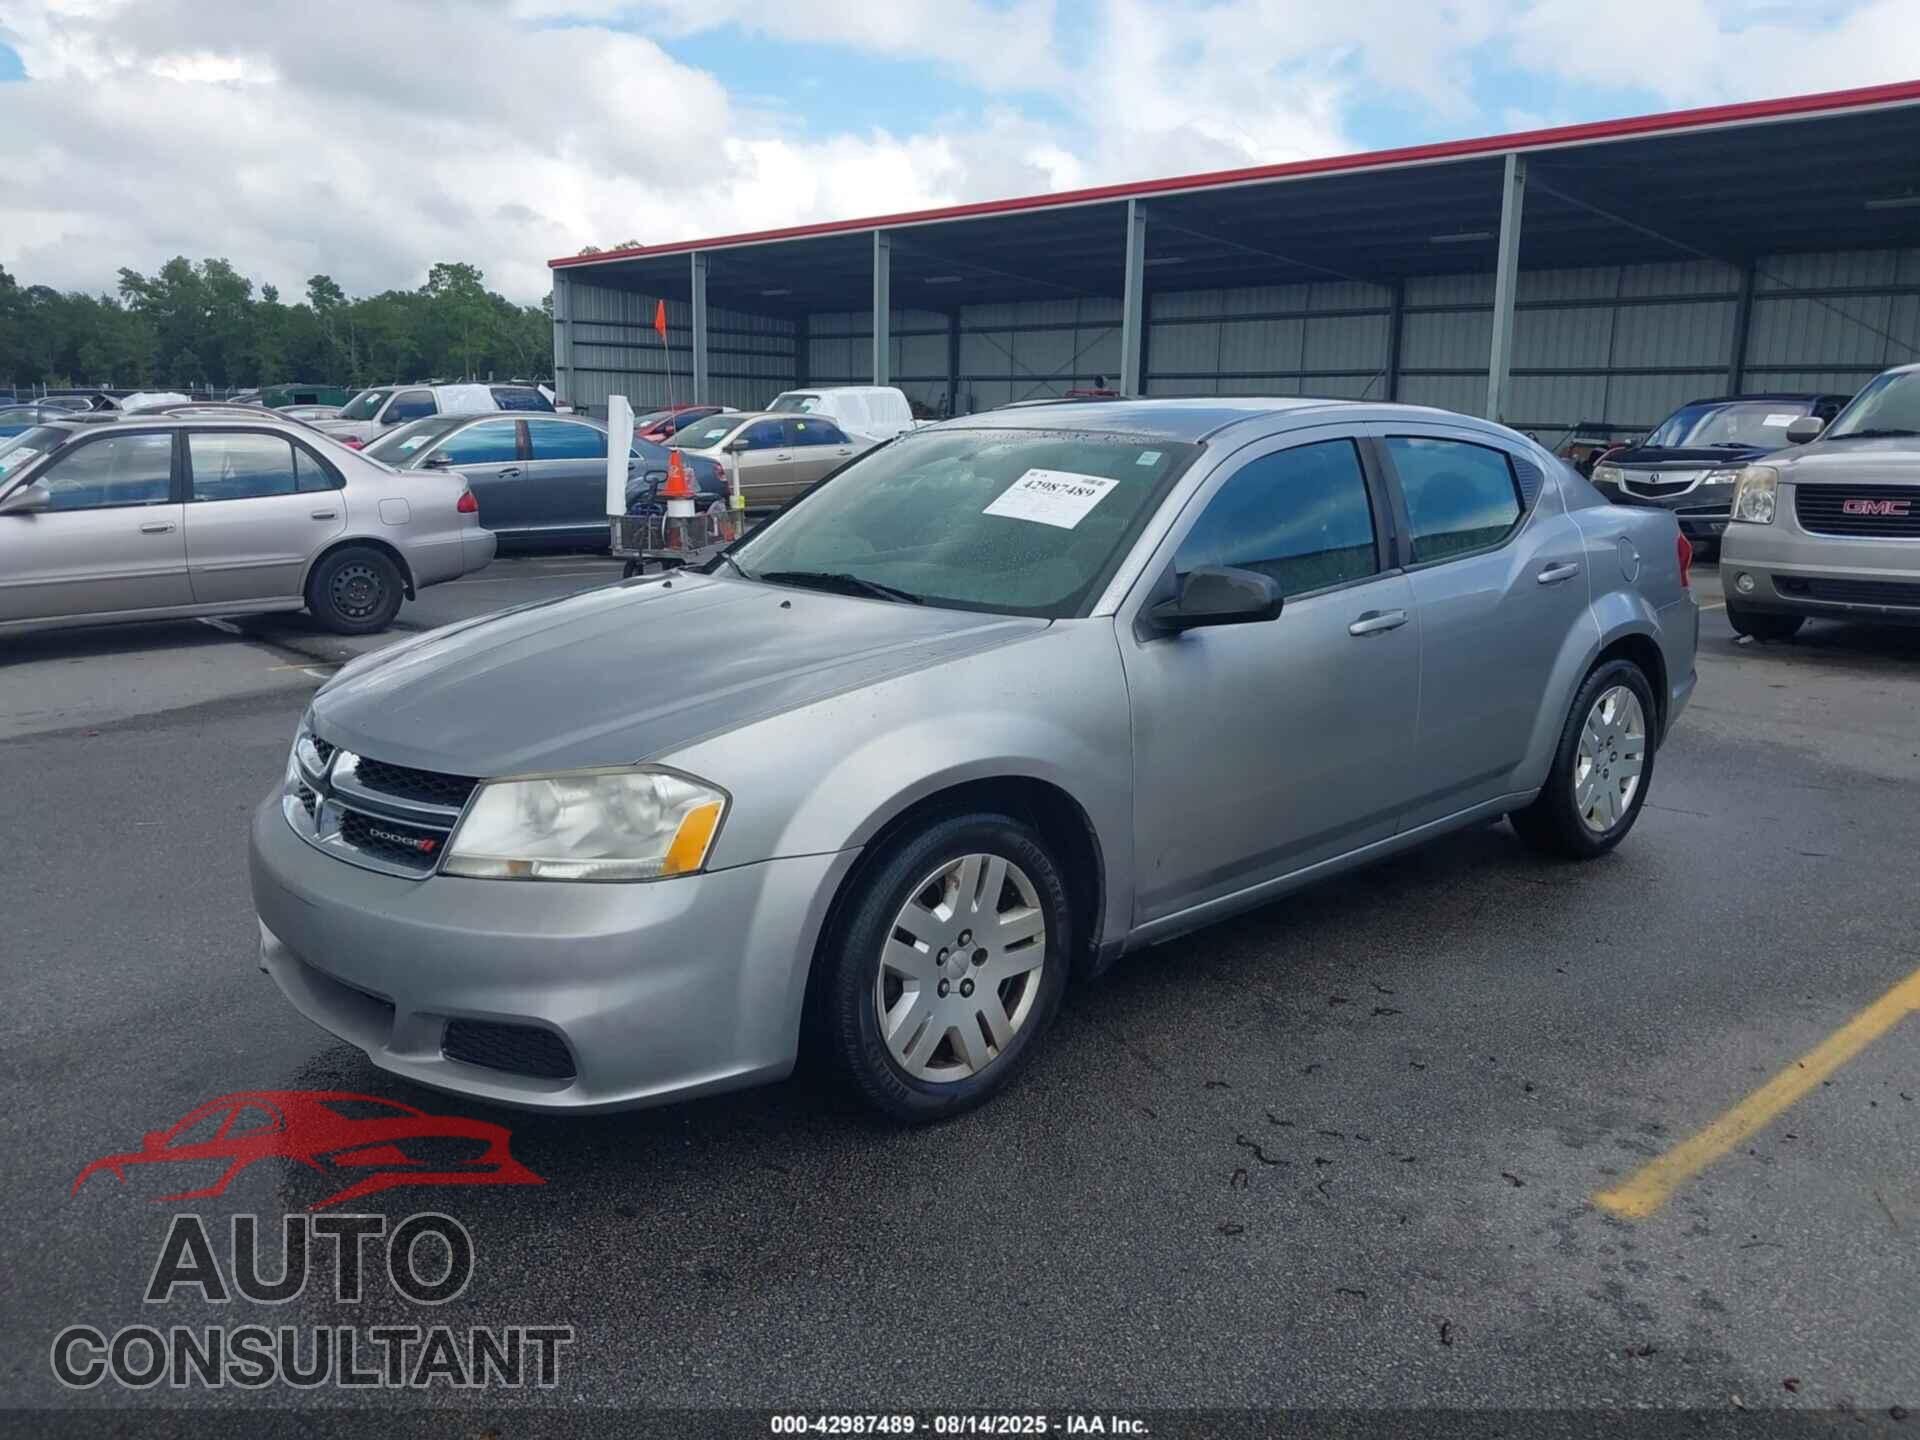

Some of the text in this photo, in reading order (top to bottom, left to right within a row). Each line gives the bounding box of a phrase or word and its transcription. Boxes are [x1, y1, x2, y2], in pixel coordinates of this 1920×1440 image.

[1023, 479, 1096, 498] 42987489
[1843, 500, 1911, 515] GMC
[369, 828, 422, 846] DODGE
